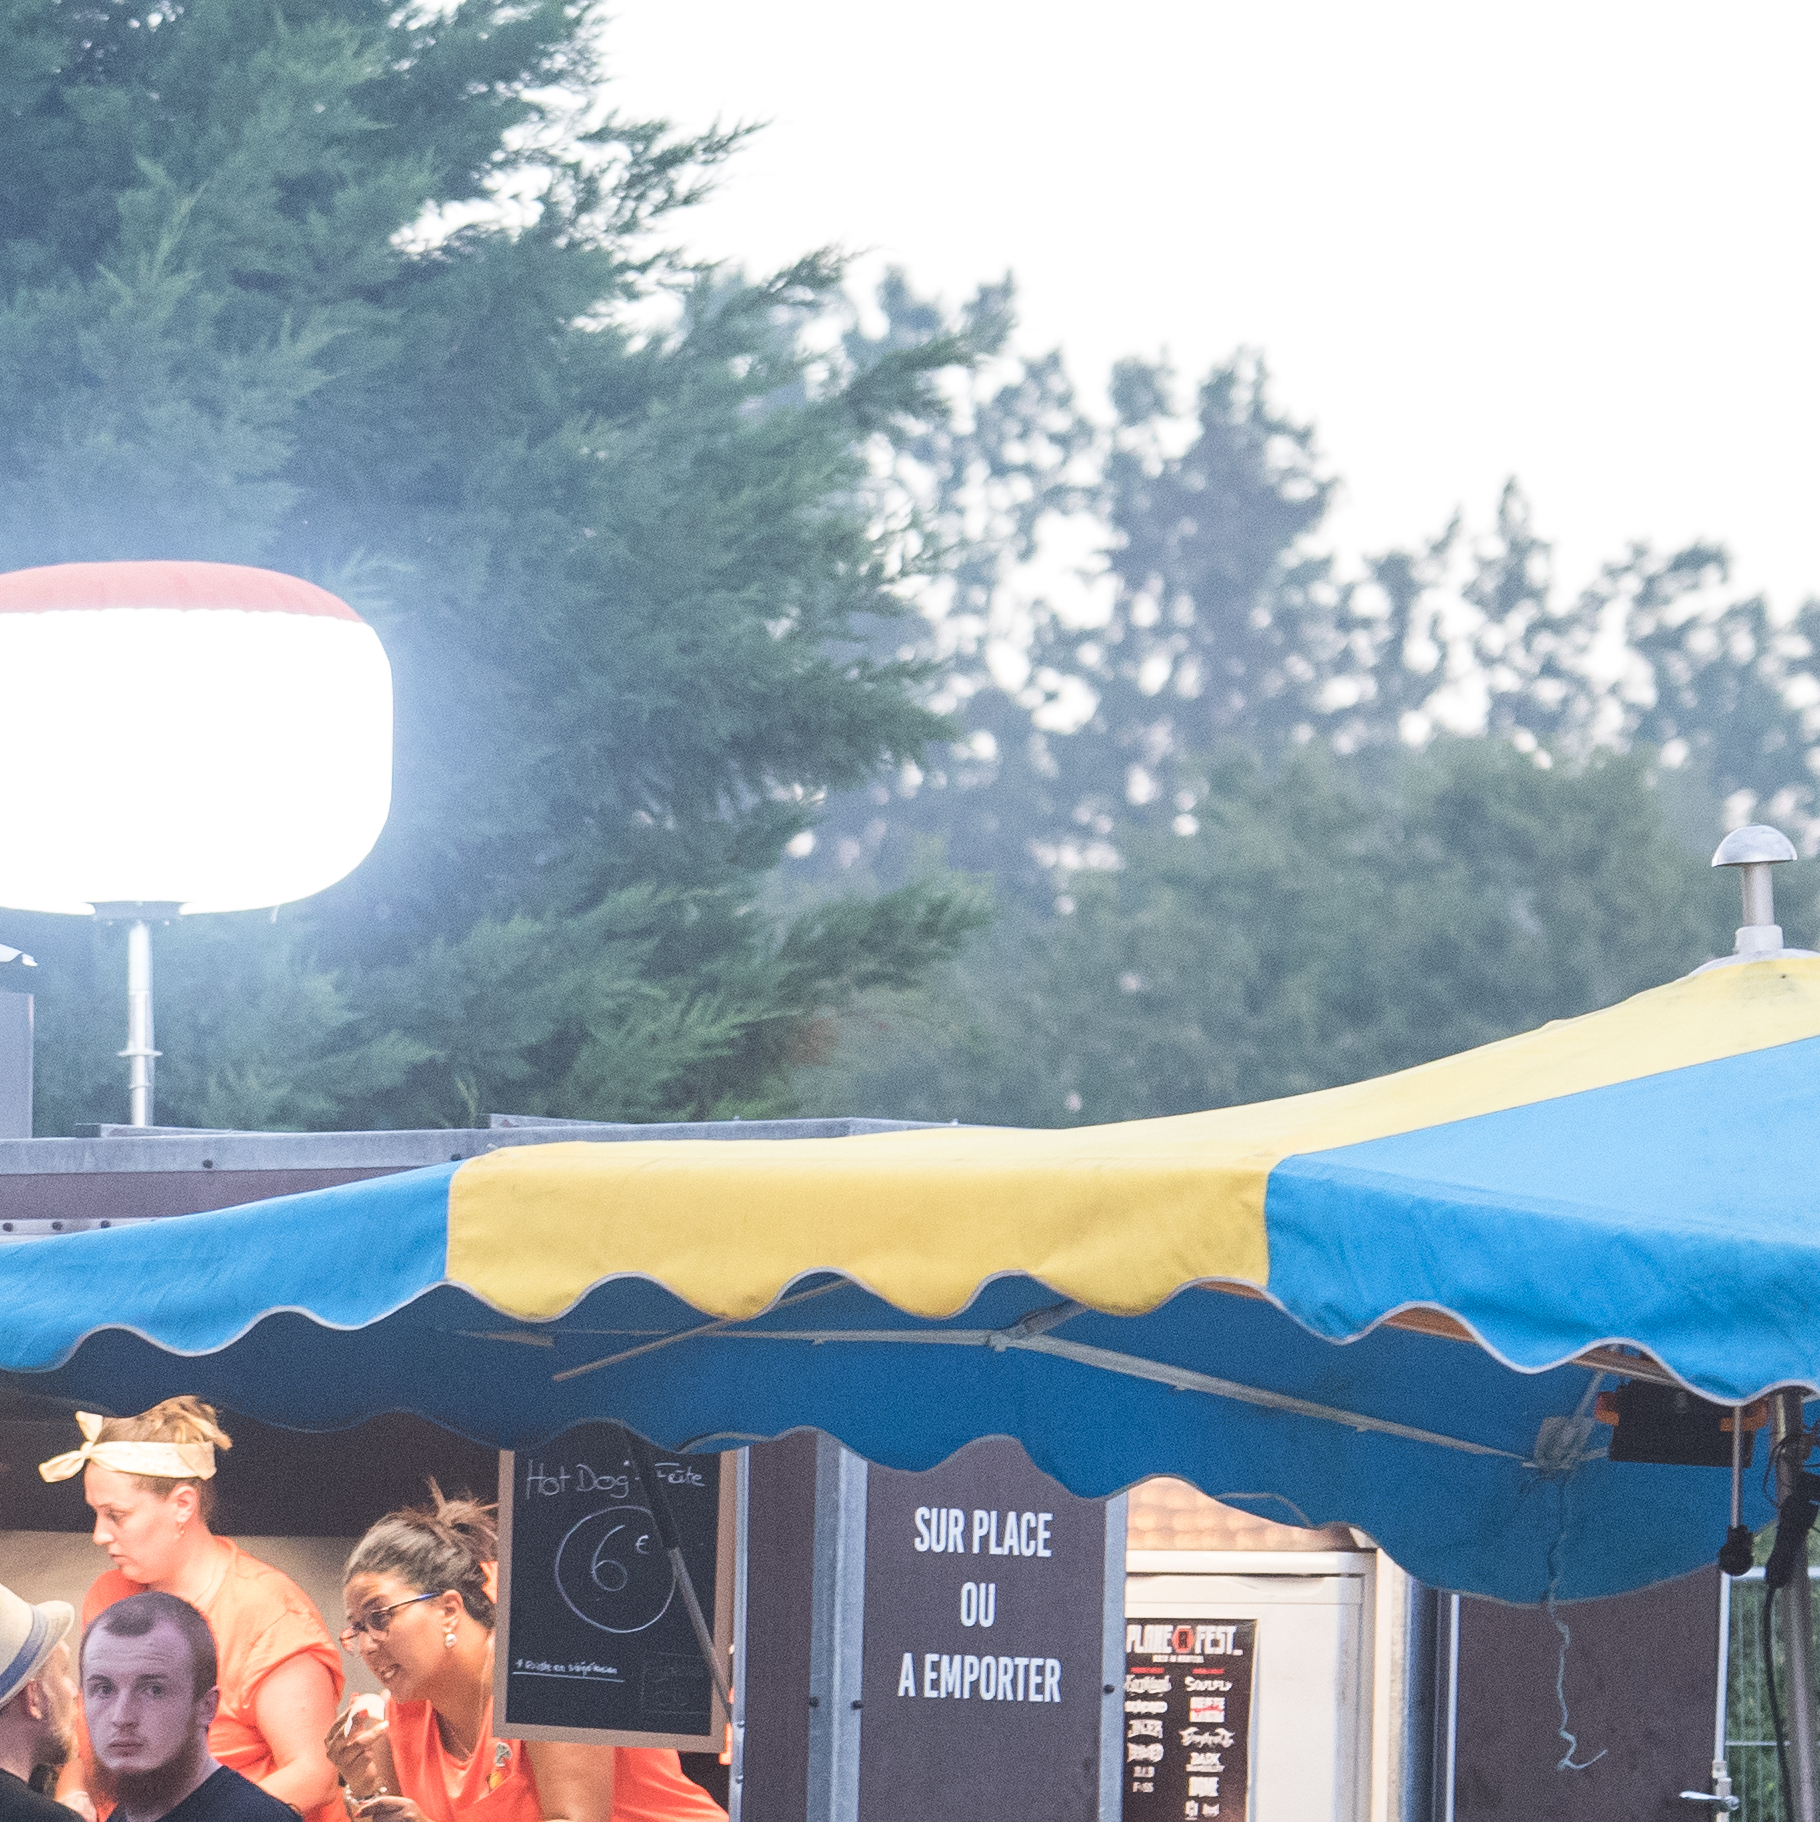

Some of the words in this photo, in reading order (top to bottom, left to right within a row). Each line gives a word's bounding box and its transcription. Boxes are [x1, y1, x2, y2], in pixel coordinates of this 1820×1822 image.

[914, 1506, 965, 1554] SUR
[972, 1509, 1053, 1558] PLACE
[960, 1581, 996, 1627] OU
[897, 1652, 916, 1697] A
[924, 1653, 1061, 1703] EMPORTER
